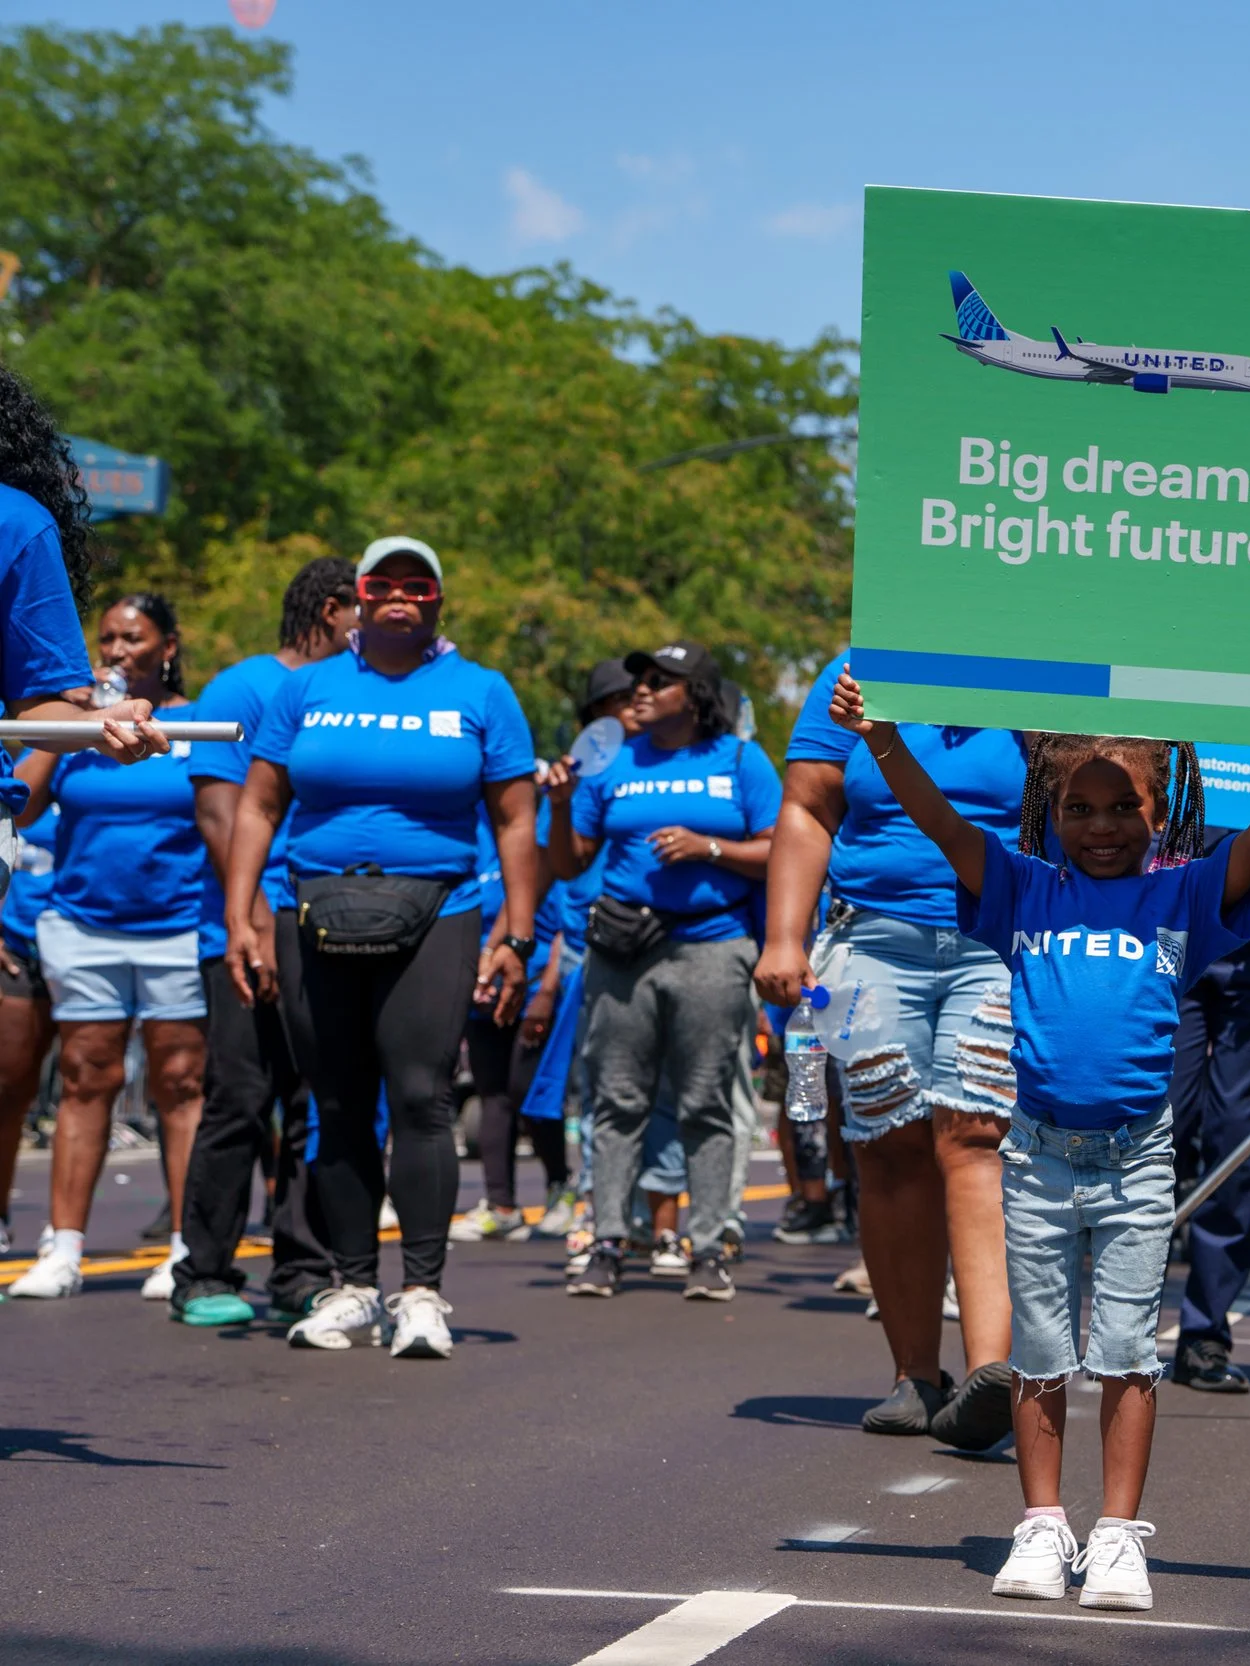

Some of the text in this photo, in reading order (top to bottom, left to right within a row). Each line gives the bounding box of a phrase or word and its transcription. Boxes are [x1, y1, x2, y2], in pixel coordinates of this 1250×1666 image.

[1124, 353, 1225, 372] UNITED
[959, 436, 1048, 502] Big
[921, 498, 1094, 565] Bright
[303, 711, 423, 730] UNITED
[614, 779, 704, 798] UNITED
